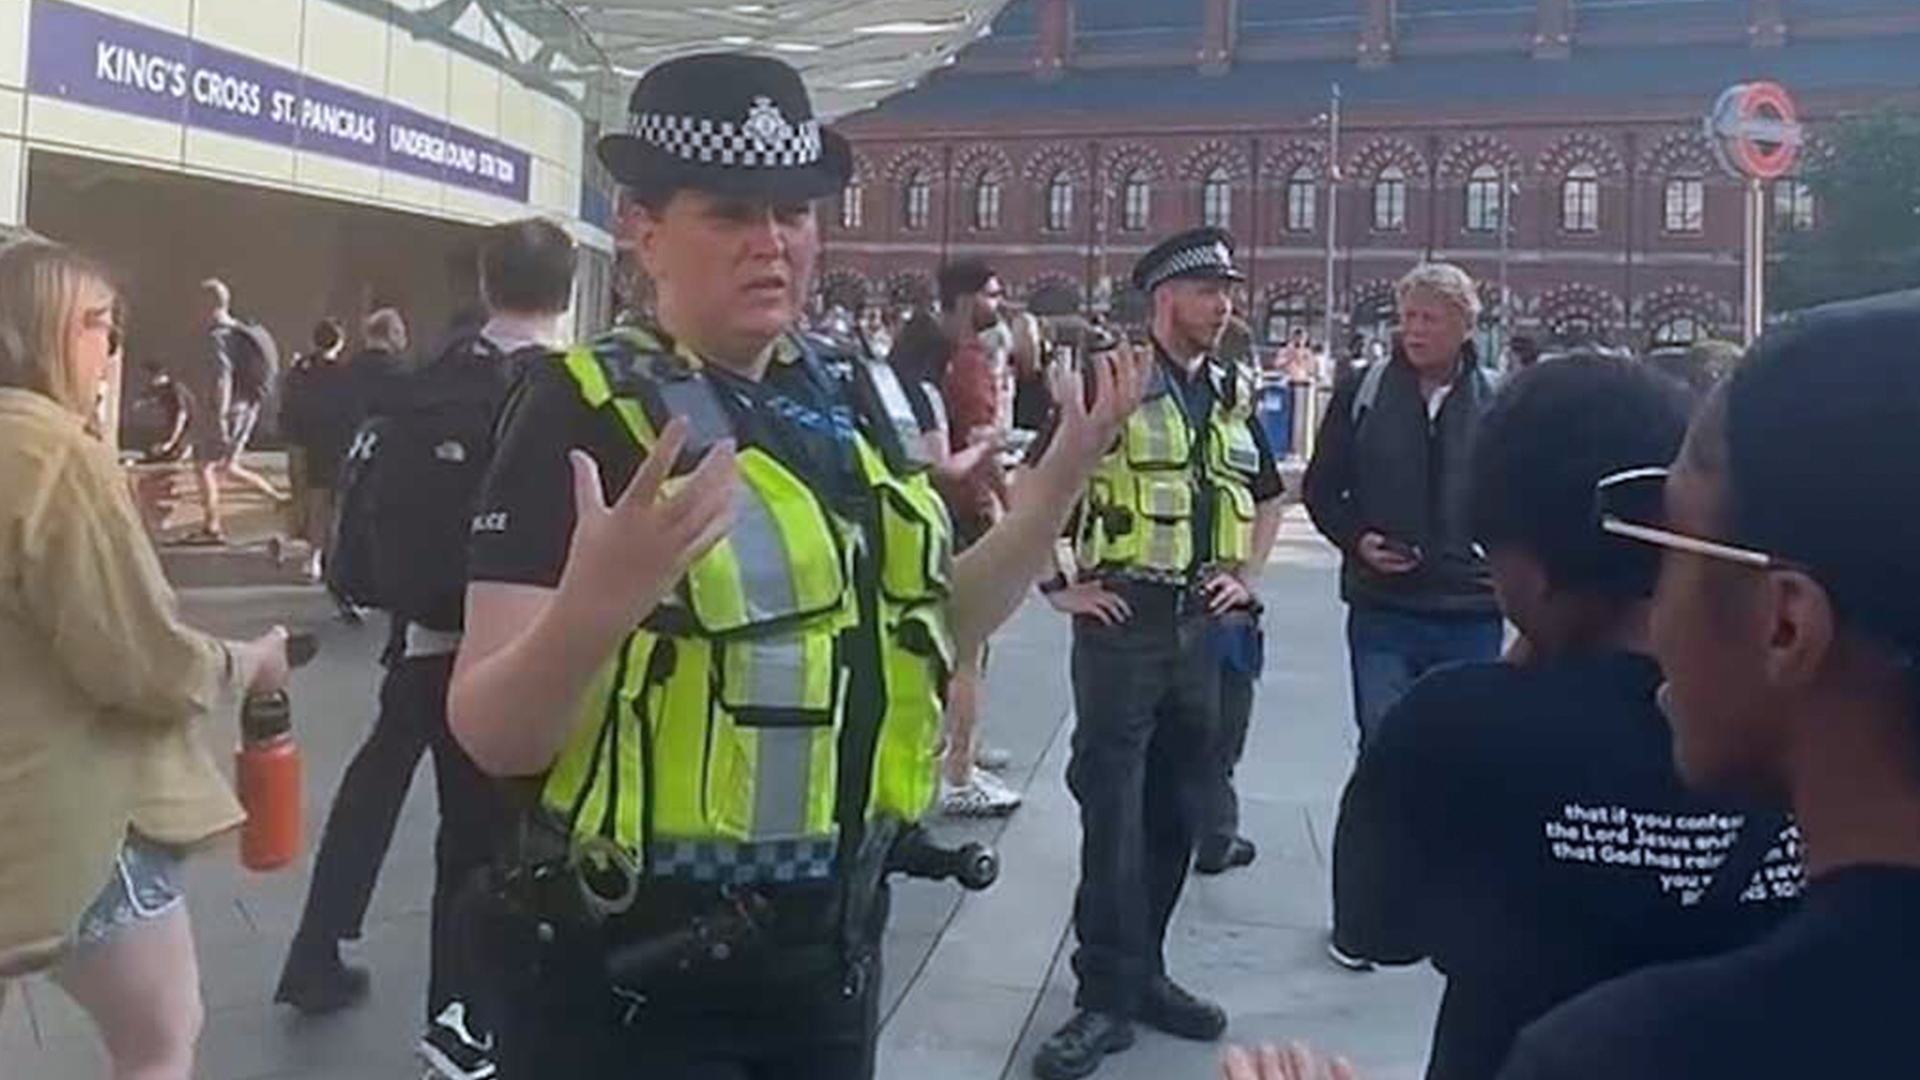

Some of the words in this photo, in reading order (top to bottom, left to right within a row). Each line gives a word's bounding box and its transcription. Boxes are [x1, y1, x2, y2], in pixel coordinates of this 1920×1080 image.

[97, 41, 187, 98] KING'S
[193, 68, 260, 116] CROSS
[301, 97, 375, 144] PANCRAS
[1564, 803, 1608, 824] that
[1632, 812, 1671, 832] you
[1546, 821, 1579, 841] the
[1582, 823, 1629, 845] Lord
[1634, 828, 1691, 850] Jesus
[1552, 840, 1596, 862] that
[1600, 844, 1642, 867] God
[1644, 847, 1681, 869] has
[1660, 873, 1699, 893] you
